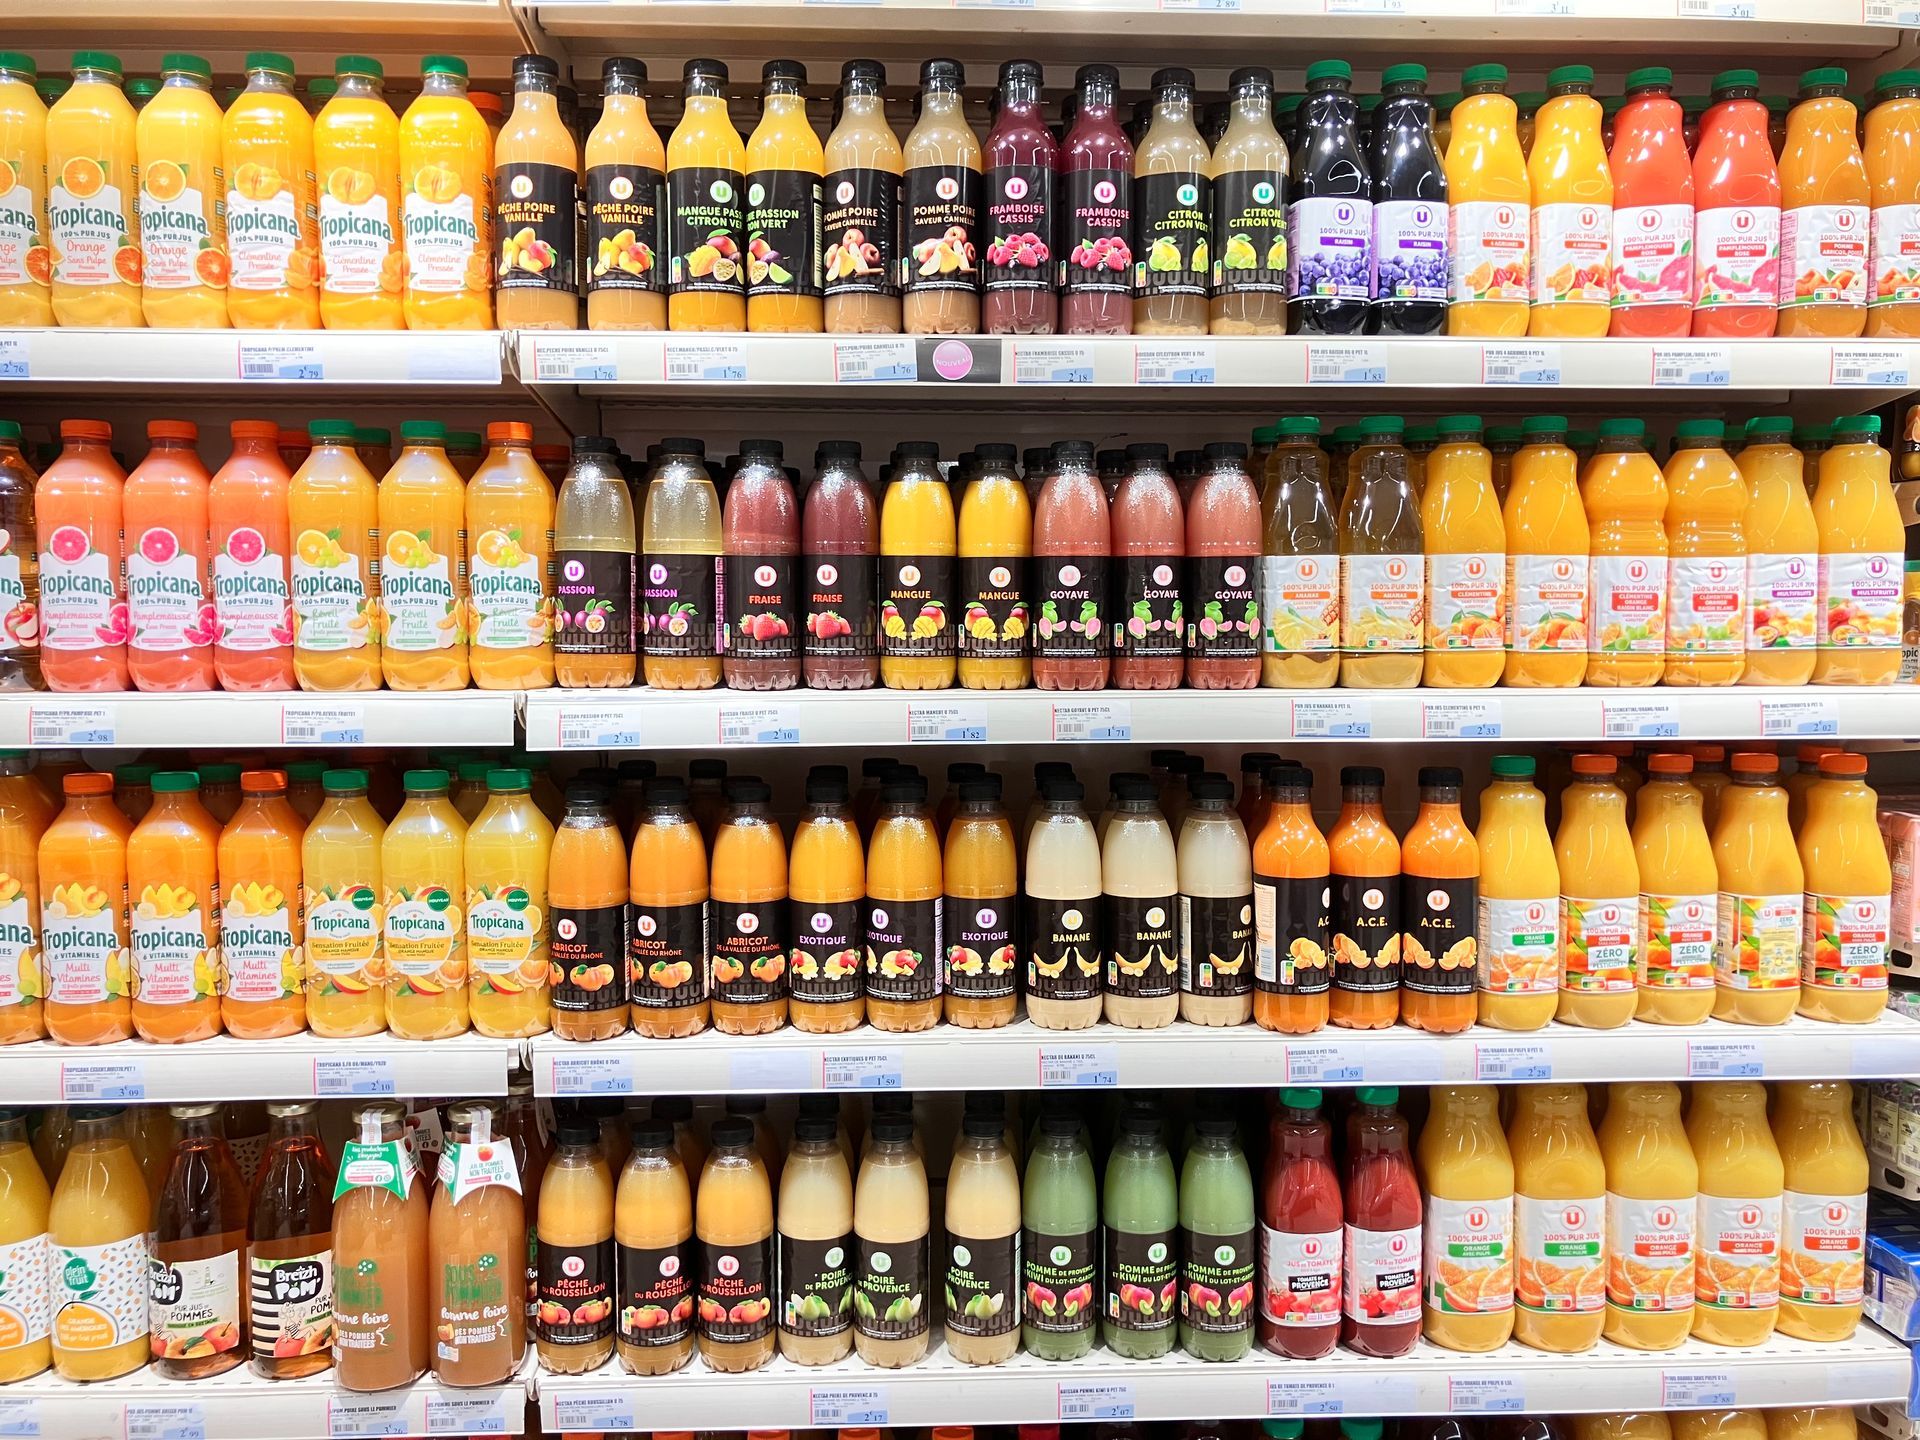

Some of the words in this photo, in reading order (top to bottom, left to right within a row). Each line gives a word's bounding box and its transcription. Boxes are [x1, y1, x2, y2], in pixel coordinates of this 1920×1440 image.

[529, 203, 556, 215] POIRE
[622, 204, 654, 217] POIRE
[677, 206, 713, 217] MANGUE
[756, 208, 799, 219] PASSION
[848, 207, 878, 219] POIRE
[913, 206, 950, 216] POMME
[989, 204, 1045, 216] FRAMBOISE
[1076, 208, 1130, 219] FRAMBOISE
[1168, 208, 1203, 219] CITRON
[1243, 208, 1281, 218] CITRON
[50, 202, 125, 233] Tropicana
[140, 206, 206, 233] ropicana
[227, 207, 298, 236] Tropicana
[504, 212, 544, 223] VANILLE
[601, 213, 643, 225] VANILLE
[687, 216, 725, 227] CITRON
[763, 218, 788, 229] VERT
[998, 212, 1034, 225] CASSIS
[1086, 216, 1121, 228] CASSIS
[1229, 217, 1266, 229] CITRON
[319, 211, 391, 240] Tropicana
[404, 210, 476, 241] Tropicana
[1154, 219, 1185, 231] CITRON
[41, 569, 114, 597] Tropicana
[128, 569, 201, 598] Tropicana
[215, 569, 287, 598] Tropicana
[293, 570, 364, 599] Tropicana
[381, 569, 454, 598] Tropicana
[470, 569, 541, 598] Tropicana
[558, 585, 595, 595] PASSION
[890, 590, 931, 600] MANGUE
[978, 591, 1019, 601] MANGUE
[1050, 590, 1089, 600] GOYAVE
[1145, 589, 1179, 599] GOYAVE
[1215, 590, 1253, 600] GOYAVE
[749, 595, 782, 605] FRAISE
[812, 594, 843, 604] FRAISE
[311, 915, 370, 932] Tropicana
[389, 914, 445, 932] Tropicana
[470, 914, 525, 931] Tropicana
[1356, 917, 1388, 928] A.C.E.
[1420, 918, 1455, 929] A.C.E.
[43, 926, 118, 948] Tropicana
[131, 926, 206, 948] Tropicana
[220, 926, 292, 948] Tropicana
[726, 936, 769, 946] ABRICOT
[799, 934, 847, 946] EXOTIQUE
[961, 931, 1009, 941] EXOTIQUE
[1052, 932, 1090, 943] BANANE
[1136, 930, 1172, 941] BANANE
[552, 942, 588, 953] ABRICOT
[1595, 946, 1624, 959] ZÉRO
[1679, 944, 1706, 955] ZÉRO
[1849, 944, 1878, 956] ZÉRO
[1804, 1227, 1827, 1236] 100%
[1829, 1227, 1847, 1236] PUR
[1848, 1226, 1862, 1235] JUS
[1447, 1233, 1469, 1243] 100%
[1471, 1233, 1487, 1243] PUR
[1489, 1232, 1503, 1242] JUS
[1819, 1237, 1848, 1246] ORANGE
[1462, 1244, 1490, 1252] ORANGE
[1560, 1243, 1587, 1251] ORANGE
[1650, 1244, 1677, 1252] ORANGE
[1734, 1242, 1763, 1250] ORANGE
[275, 1265, 317, 1282] Breizh
[951, 1266, 975, 1280] POIRE
[1026, 1261, 1056, 1275] POMME
[1119, 1262, 1154, 1275] POMME
[1187, 1262, 1221, 1274] POMME
[821, 1268, 847, 1281] POIRE
[867, 1273, 895, 1284] POIRE
[1027, 1269, 1044, 1282] KIWI
[1119, 1271, 1141, 1283] KIWI
[1188, 1270, 1208, 1283] KIWI
[556, 1277, 589, 1288] PÊCHE
[654, 1276, 684, 1290] PÊCHE
[713, 1278, 744, 1289] PÊCHE
[863, 1280, 910, 1292] PROVENCE
[1291, 1278, 1330, 1290] PROVENCE
[1380, 1275, 1415, 1288] PROVENCE
[549, 1282, 606, 1298] ROUSSILLON
[706, 1282, 762, 1296] ROUSSILLON
[170, 1308, 213, 1321] POMMES
